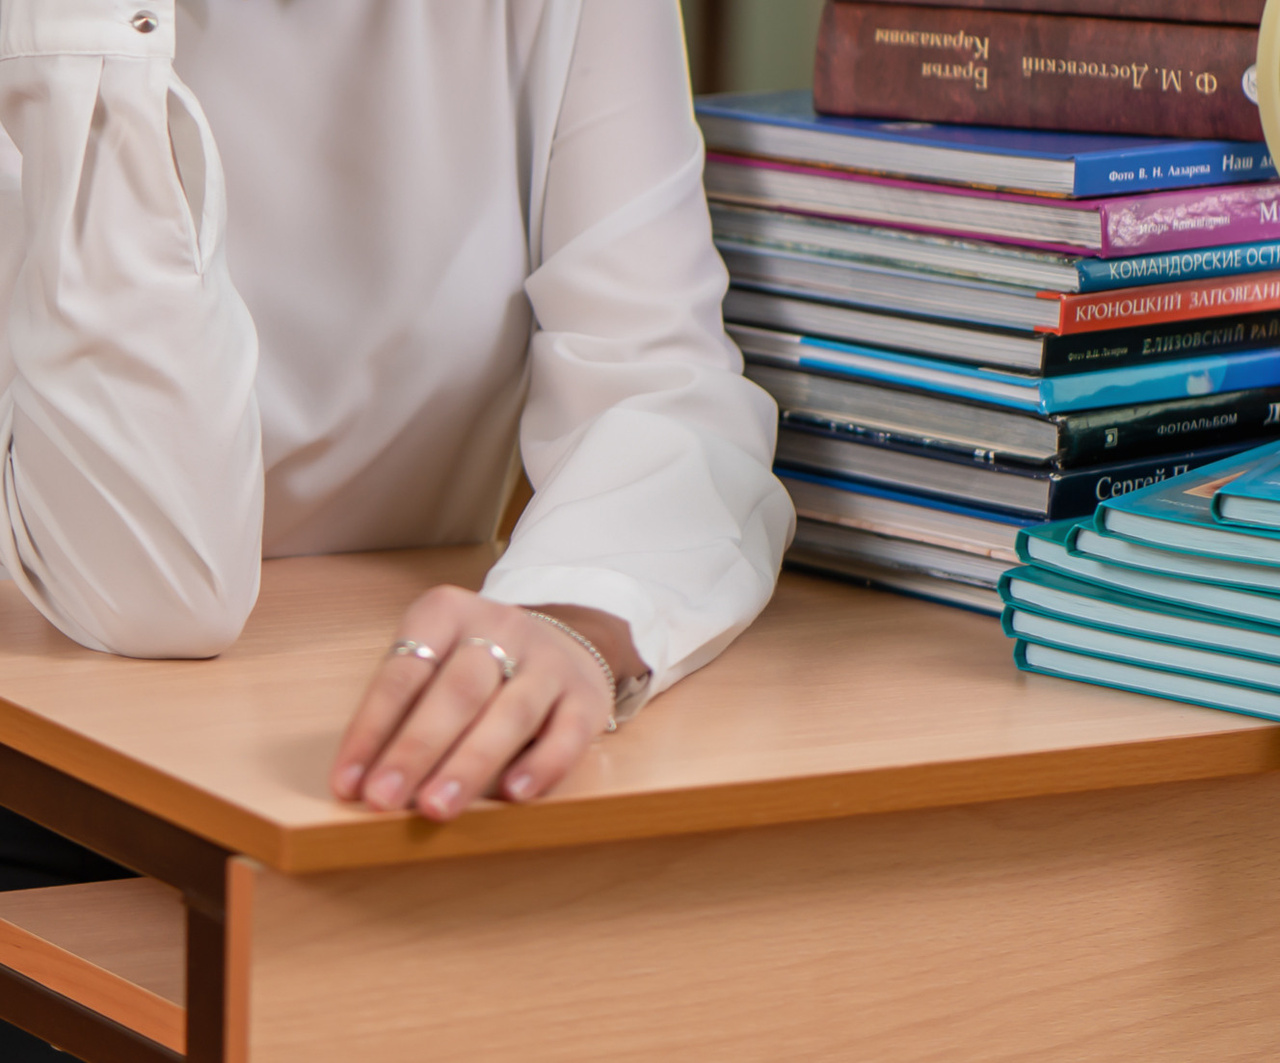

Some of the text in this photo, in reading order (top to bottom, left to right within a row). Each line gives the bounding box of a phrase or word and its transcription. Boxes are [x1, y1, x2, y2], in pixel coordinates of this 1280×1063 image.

[874, 27, 990, 60] Карамазовы
[922, 61, 988, 90] Братья
[1022, 56, 1149, 90] Достоевский
[1154, 67, 1182, 93] М.
[1189, 70, 1218, 94] Ф.
[1109, 170, 1134, 182] Фото
[1139, 167, 1148, 179] В.
[1152, 166, 1163, 178] Н.
[1168, 163, 1210, 178] Лазарева
[1222, 153, 1253, 172] Наш
[1109, 249, 1241, 280] КОМАНДОРСКИЕ
[1075, 291, 1182, 322] КРОНОЦКИЙ
[1142, 323, 1244, 355] ЕЛИЗОВСКИЙ
[1157, 412, 1238, 435] ФОТОАЛЬБОМ
